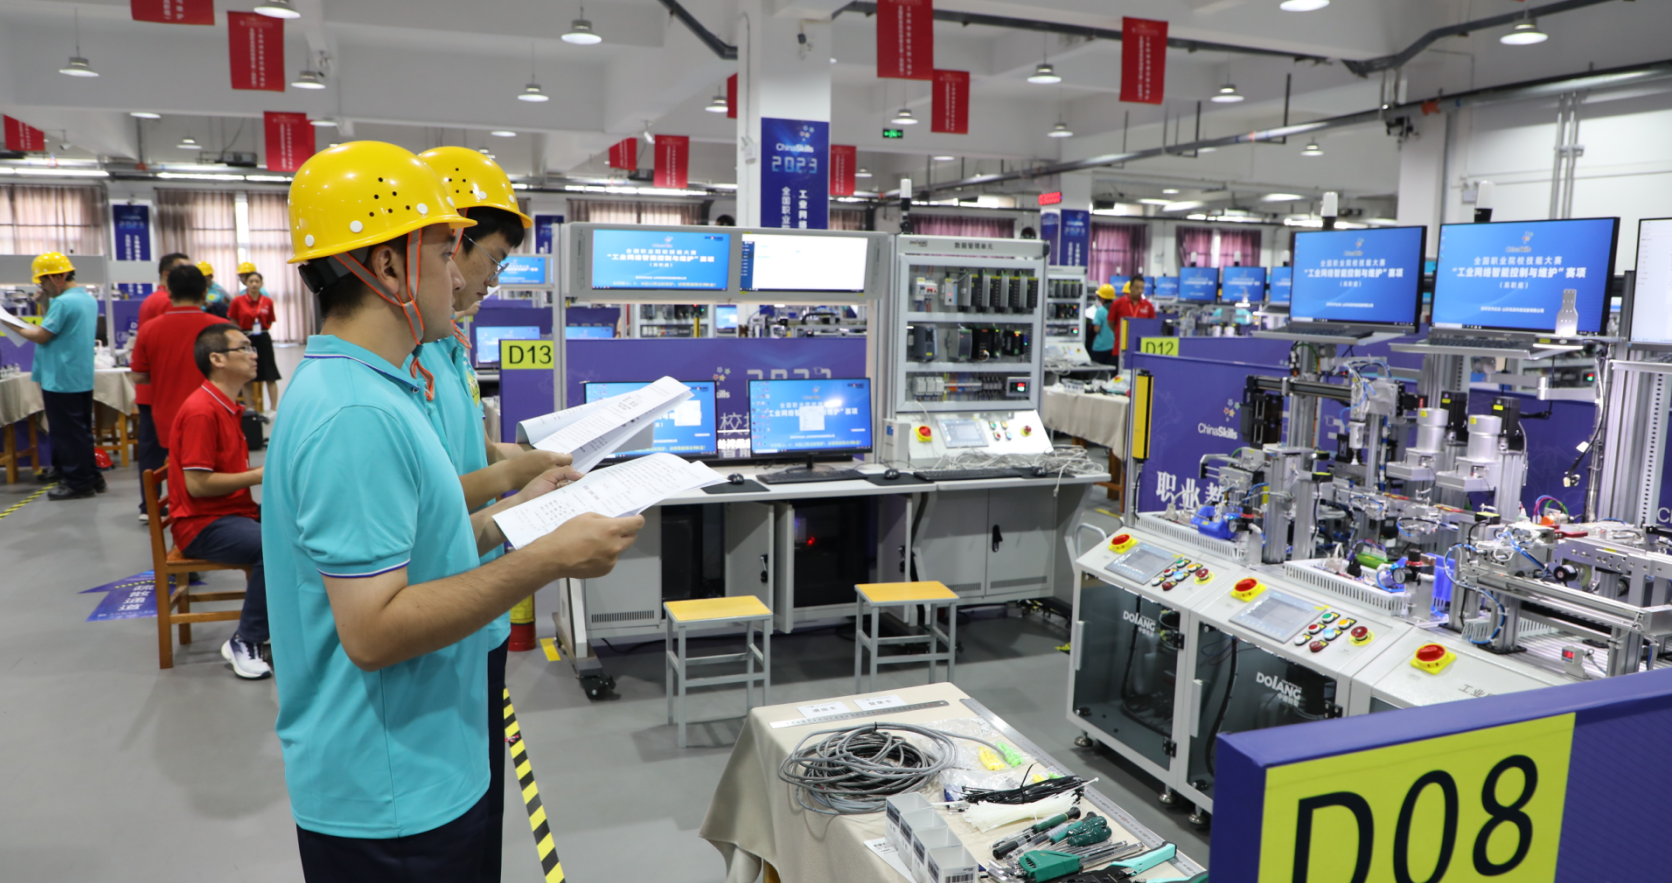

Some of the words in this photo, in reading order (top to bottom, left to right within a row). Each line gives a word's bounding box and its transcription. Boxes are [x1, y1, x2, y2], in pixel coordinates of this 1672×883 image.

[776, 142, 814, 153] ChinaSkills
[772, 155, 818, 174] 2023
[509, 345, 552, 364] D13
[1145, 341, 1174, 356] D12
[1197, 422, 1238, 440] ChinaSkills
[1291, 754, 1539, 883] D08
